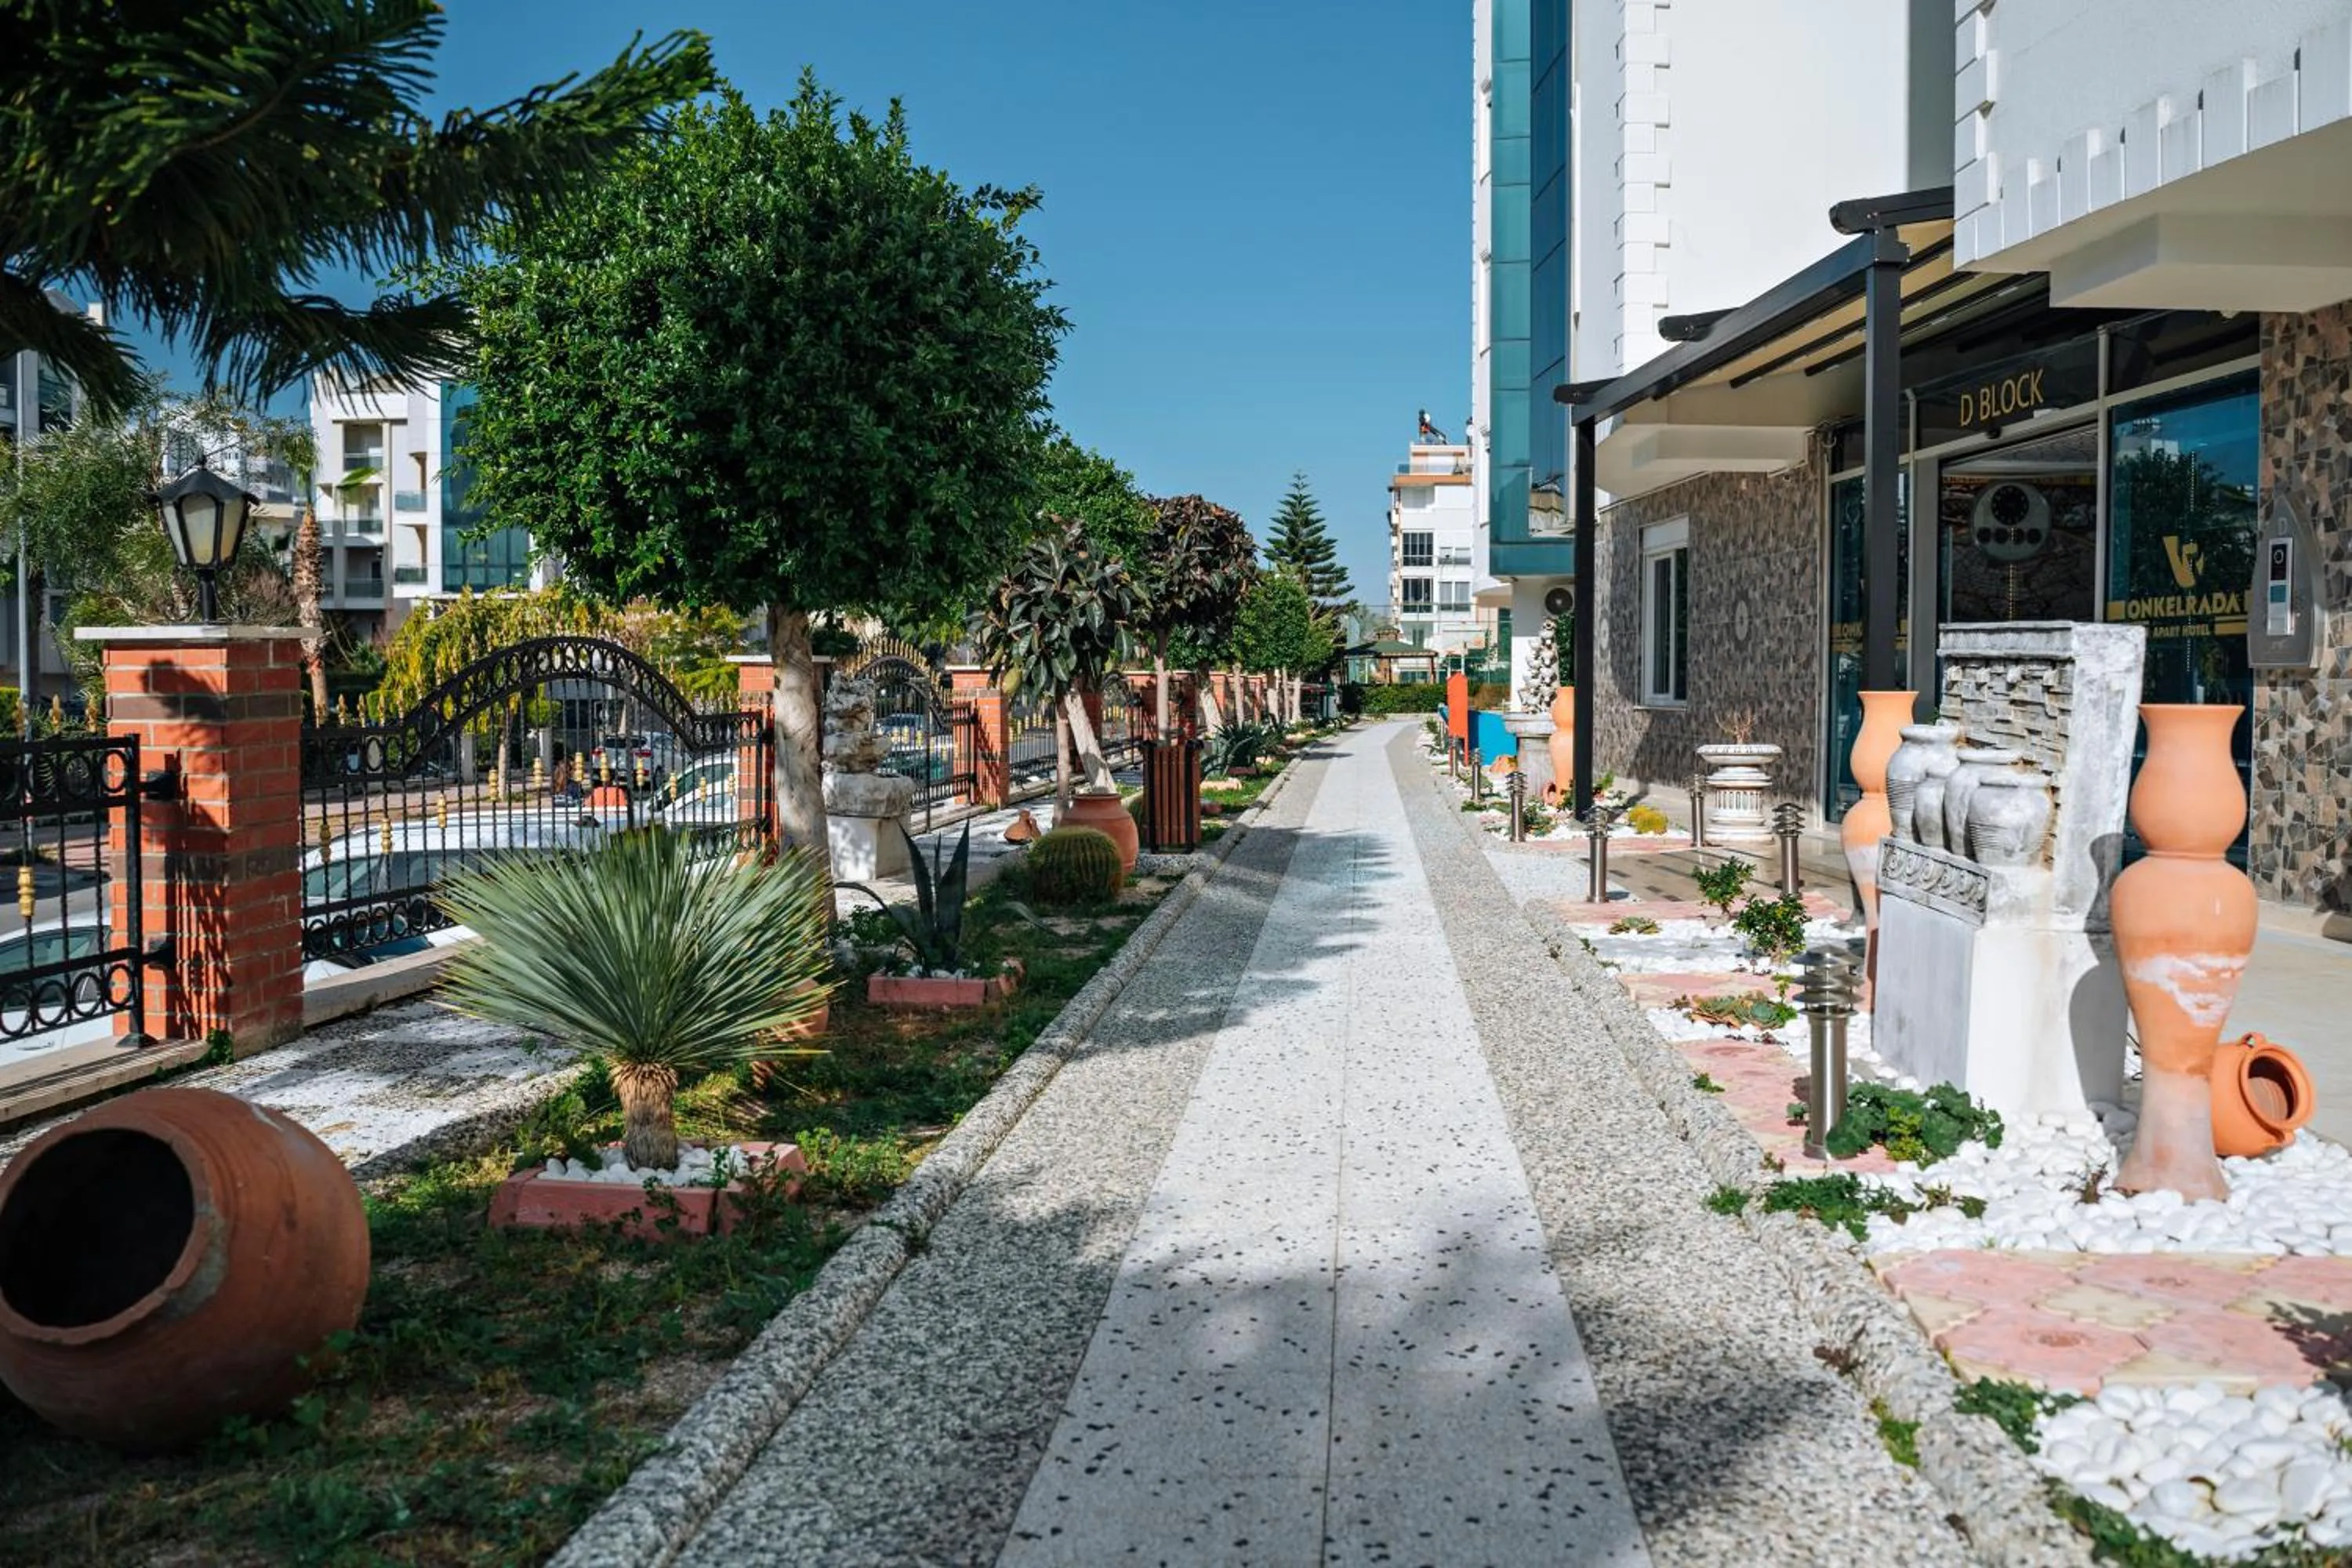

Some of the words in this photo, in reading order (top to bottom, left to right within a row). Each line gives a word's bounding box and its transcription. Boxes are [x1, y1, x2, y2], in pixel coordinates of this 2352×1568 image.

[1961, 394, 1973, 426] D
[1980, 368, 2044, 421] BLOCK
[2127, 592, 2241, 619] ONKELRADA
[2183, 624, 2210, 637] HOTEL
